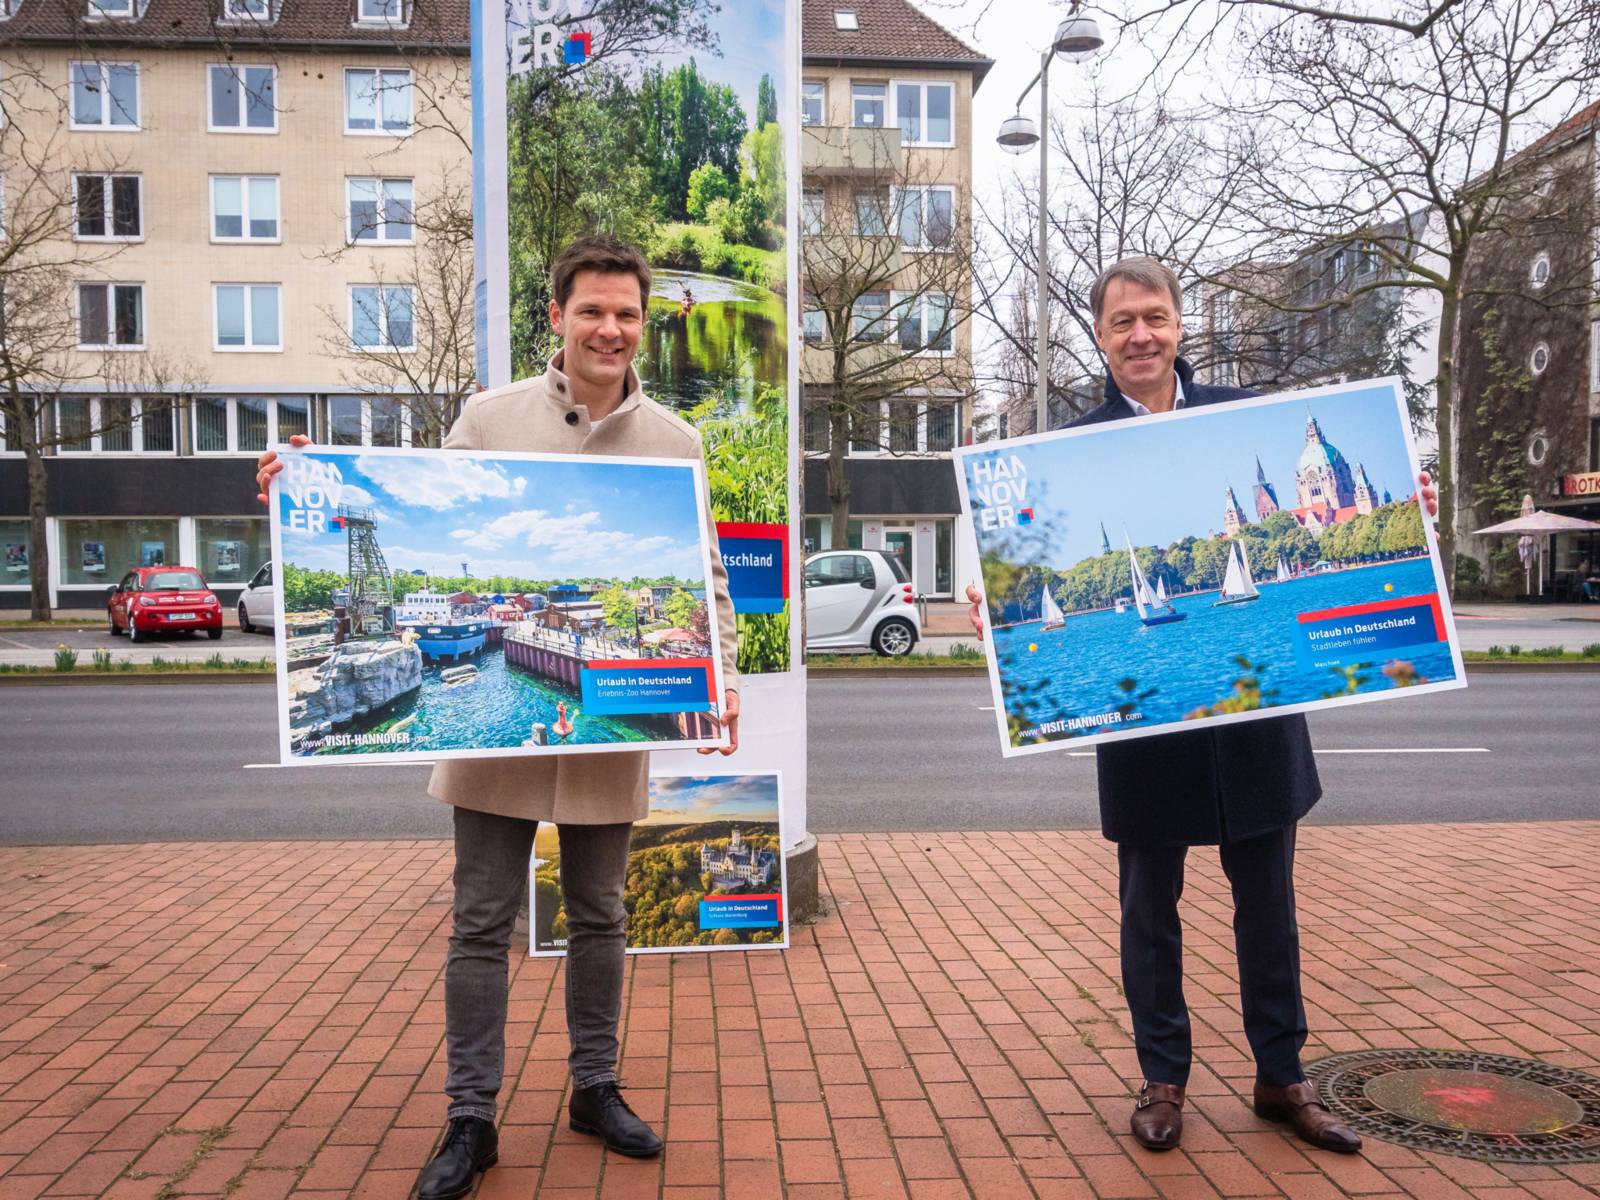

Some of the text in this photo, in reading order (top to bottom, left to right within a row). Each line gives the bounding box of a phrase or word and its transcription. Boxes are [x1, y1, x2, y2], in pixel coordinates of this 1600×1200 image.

[511, 23, 561, 74] ER
[290, 509, 325, 533] ER
[981, 505, 1016, 531] ER
[721, 552, 773, 567] tschland
[1308, 616, 1416, 640] Urlaub in Deutschland
[1312, 640, 1352, 652] Stadtleben
[597, 675, 692, 686] Urlaub in Deutschland
[598, 688, 671, 697] Erlebnis-Zoo Hannover
[1040, 711, 1122, 734] VISIT-HANNOVER
[325, 732, 410, 747] VISIT-HANNOVER
